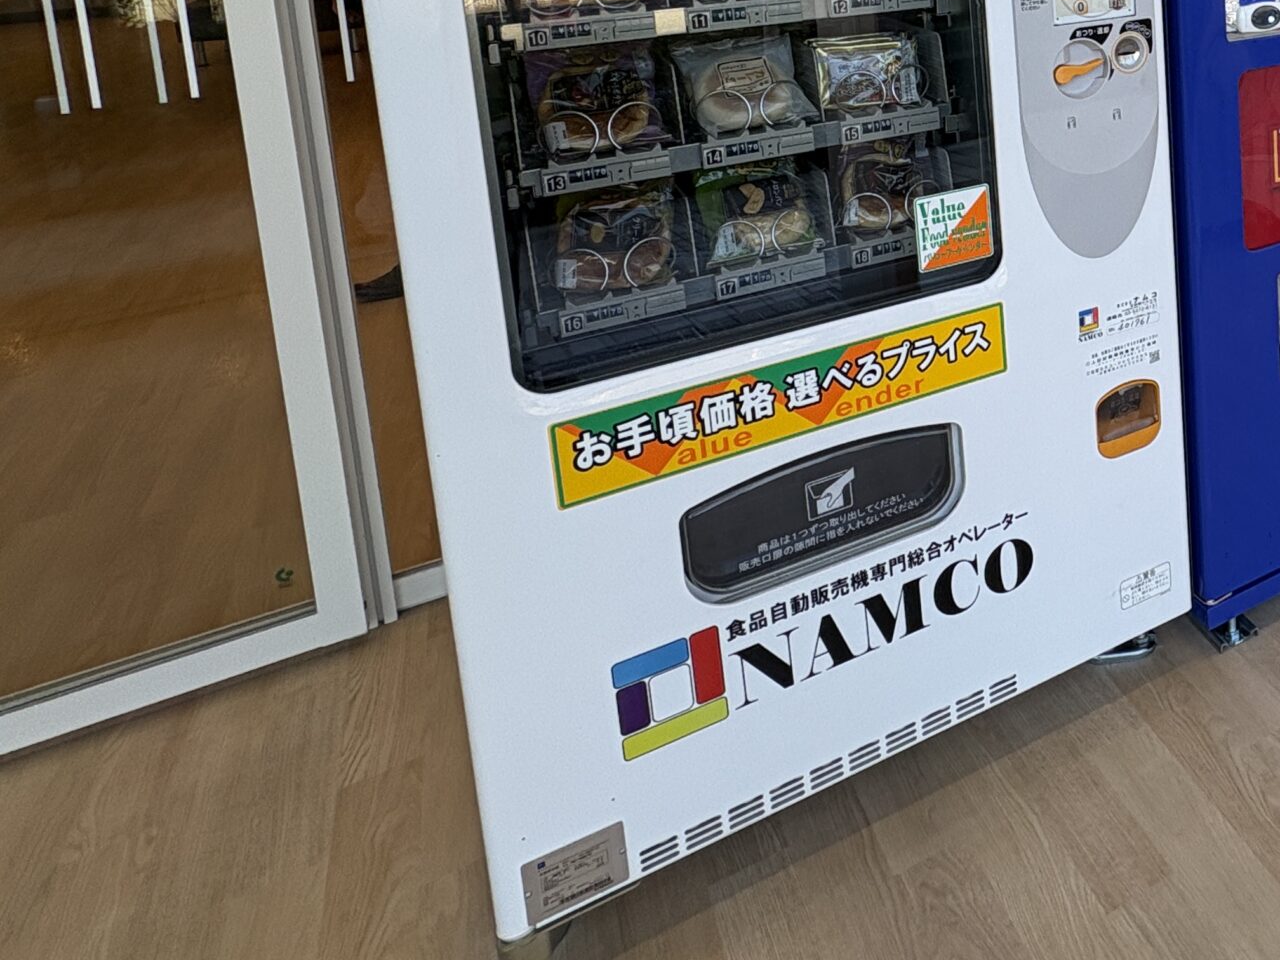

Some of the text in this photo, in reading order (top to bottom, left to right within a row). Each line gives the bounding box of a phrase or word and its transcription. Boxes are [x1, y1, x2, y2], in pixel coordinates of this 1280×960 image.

[834, 1, 847, 14] 12
[1077, 3, 1084, 12] 0
[692, 15, 707, 28] 11
[529, 32, 547, 44] 10
[846, 129, 858, 140] 15
[707, 152, 721, 164] 14
[550, 177, 565, 190] 13
[918, 198, 966, 226] Value
[921, 223, 949, 251] Food
[857, 251, 868, 264] 18
[721, 282, 735, 294] 17
[565, 318, 581, 331] 16
[573, 320, 991, 473] お手頃価格 選べるプライス
[756, 492, 907, 554] 商品は1つずつ取り出してください
[725, 511, 1029, 642] 食品自動販売機専門総合オペレーター
[727, 538, 1035, 711] NAMCO
